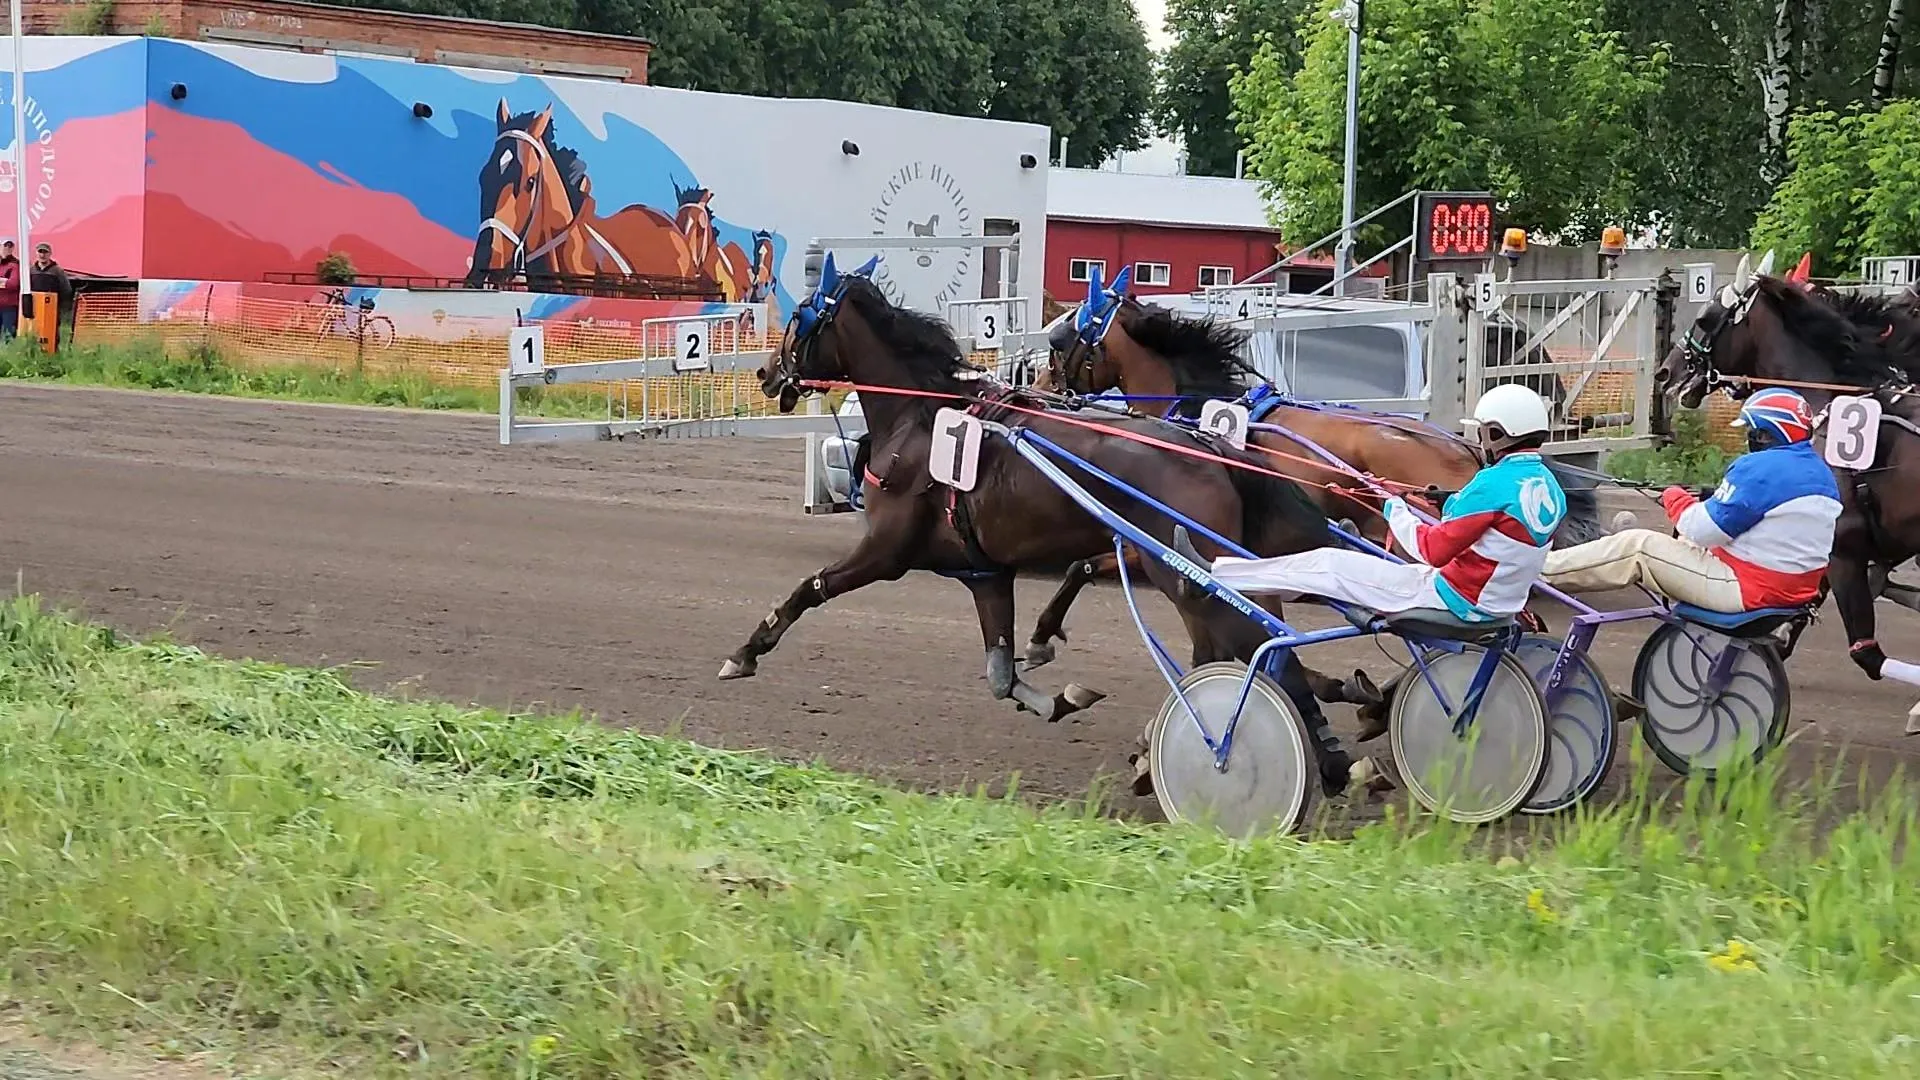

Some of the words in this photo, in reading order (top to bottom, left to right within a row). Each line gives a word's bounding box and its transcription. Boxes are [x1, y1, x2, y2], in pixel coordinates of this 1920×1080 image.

[1432, 204, 1490, 253] 0:00
[1696, 275, 1706, 295] 6
[1890, 269, 1900, 287] 7
[1482, 282, 1491, 303] 5
[1238, 298, 1249, 320] 4
[983, 315, 996, 339] 3
[522, 337, 534, 364] 1
[686, 333, 701, 359] 2
[1836, 403, 1868, 462] 3
[945, 420, 969, 483] 1
[1161, 551, 1210, 588] CUSTOM
